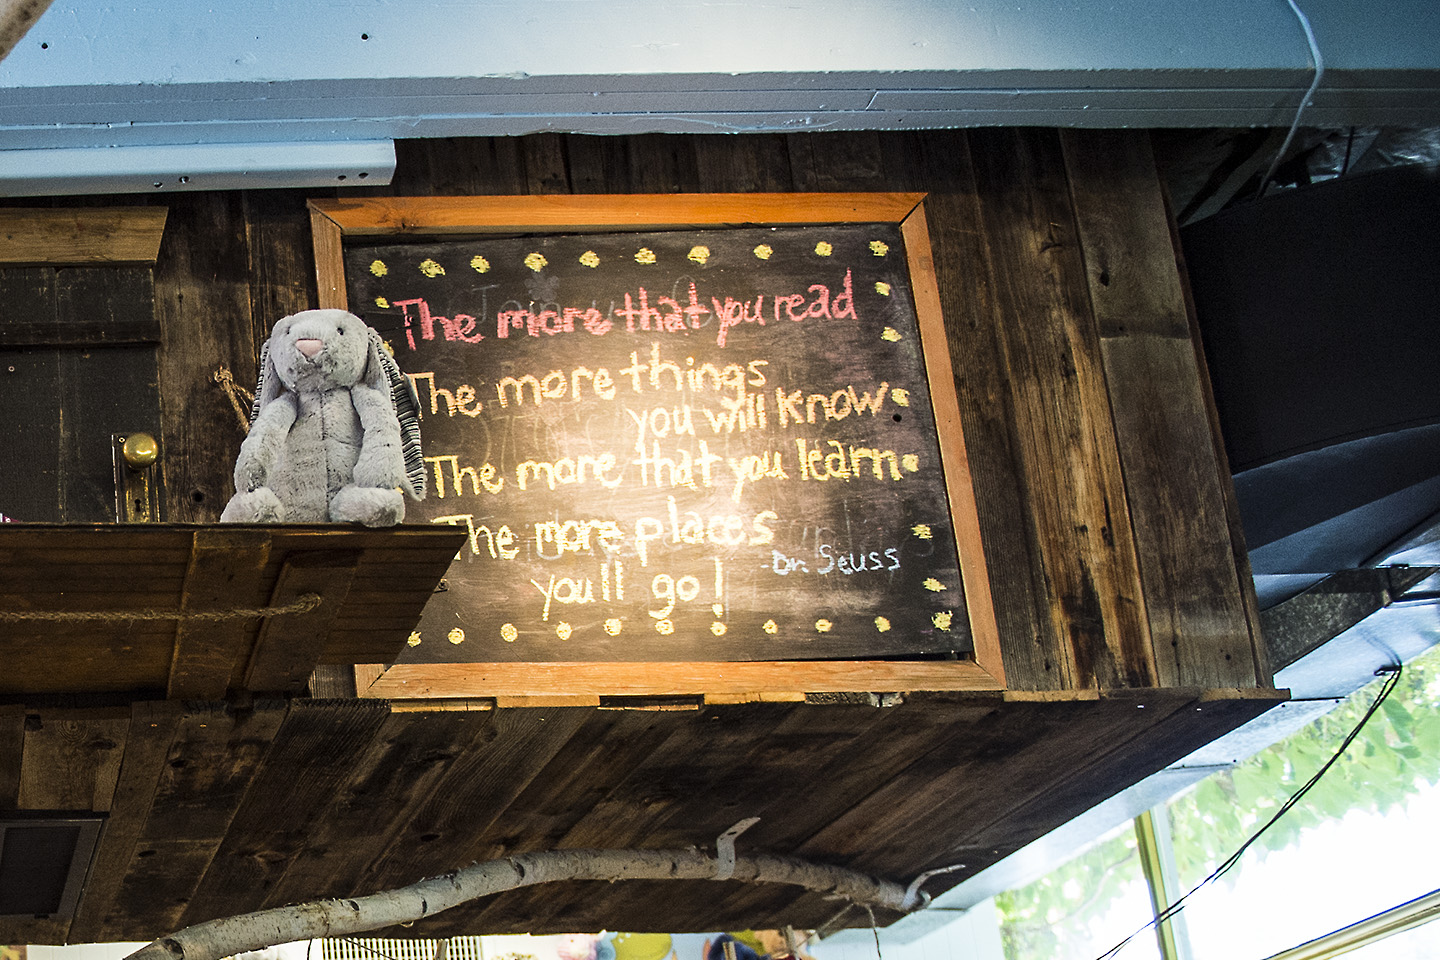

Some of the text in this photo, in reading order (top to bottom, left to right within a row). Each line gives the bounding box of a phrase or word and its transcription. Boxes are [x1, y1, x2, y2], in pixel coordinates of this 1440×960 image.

[392, 267, 858, 350] The more that you read
[403, 341, 769, 420] The more things
[626, 405, 695, 451] you
[704, 393, 767, 433] will
[424, 455, 504, 498] The
[517, 452, 623, 490] more
[632, 439, 723, 491] that
[728, 450, 790, 503] you
[430, 495, 778, 567] The more places
[817, 545, 901, 575] Seuss
